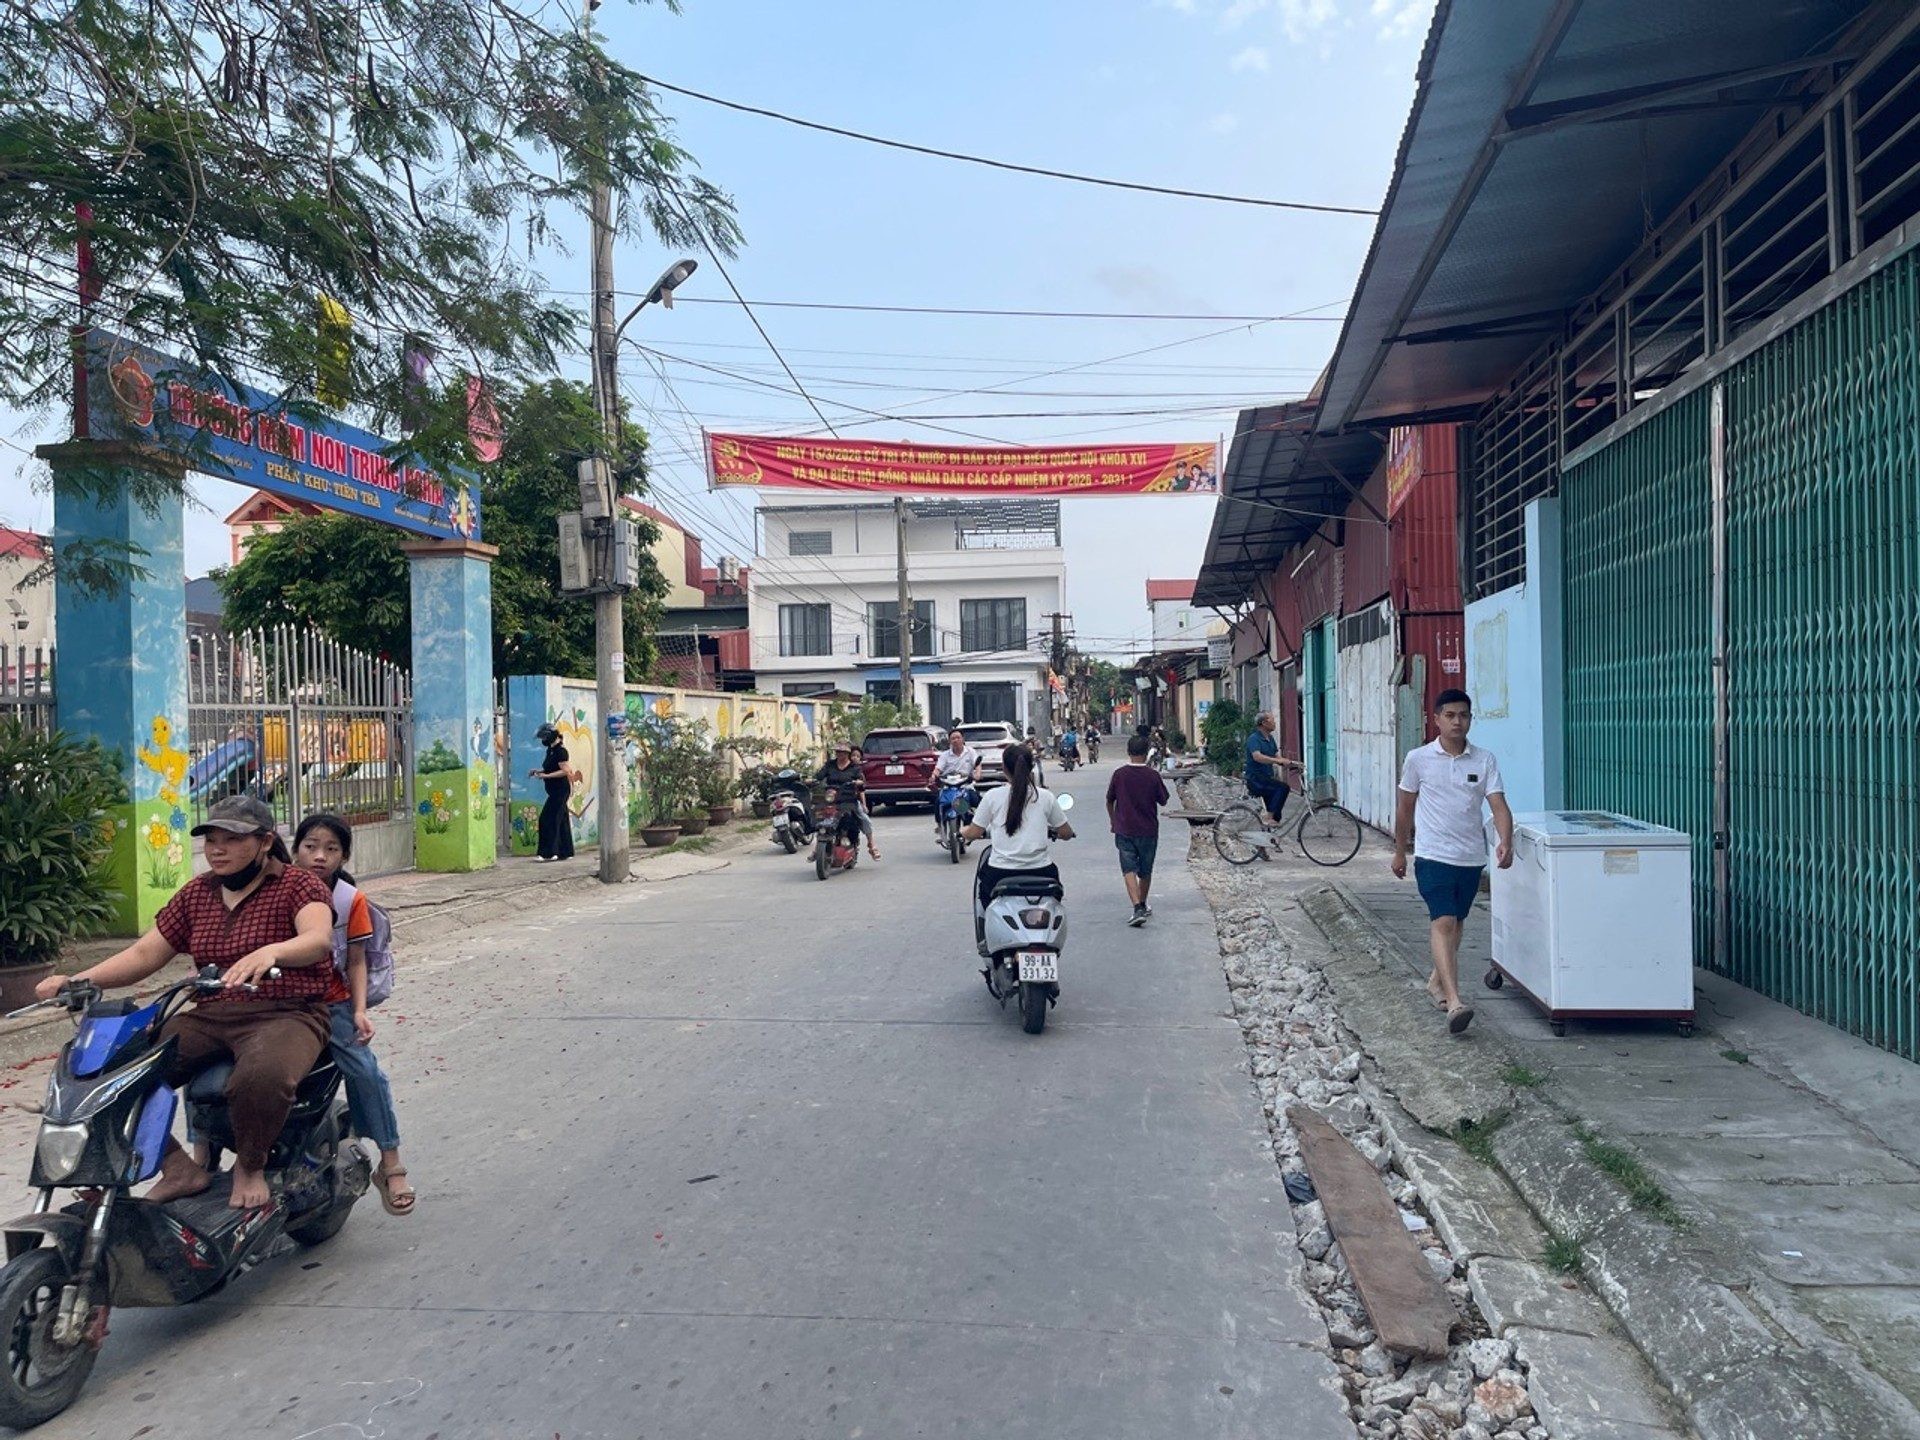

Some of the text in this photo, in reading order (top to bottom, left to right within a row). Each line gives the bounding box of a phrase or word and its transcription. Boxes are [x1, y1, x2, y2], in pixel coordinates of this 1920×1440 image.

[311, 429, 348, 476] NON
[350, 445, 400, 494] TRUNG
[777, 445, 804, 460] NGÀY
[882, 450, 898, 463] TRI
[918, 450, 946, 465] NƯỚC
[1130, 452, 1147, 466] XVI
[792, 465, 806, 480] VÀ
[808, 468, 827, 483] ĐẠI
[910, 469, 940, 484] NHÂN
[942, 470, 964, 485] DÂN
[967, 470, 988, 485] CÁC
[991, 469, 1012, 485] CẤP
[1015, 471, 1048, 488] NHIỆM
[1051, 471, 1064, 485] KỲ
[1102, 473, 1125, 485] 2031
[1022, 967, 1055, 979] 331.32
